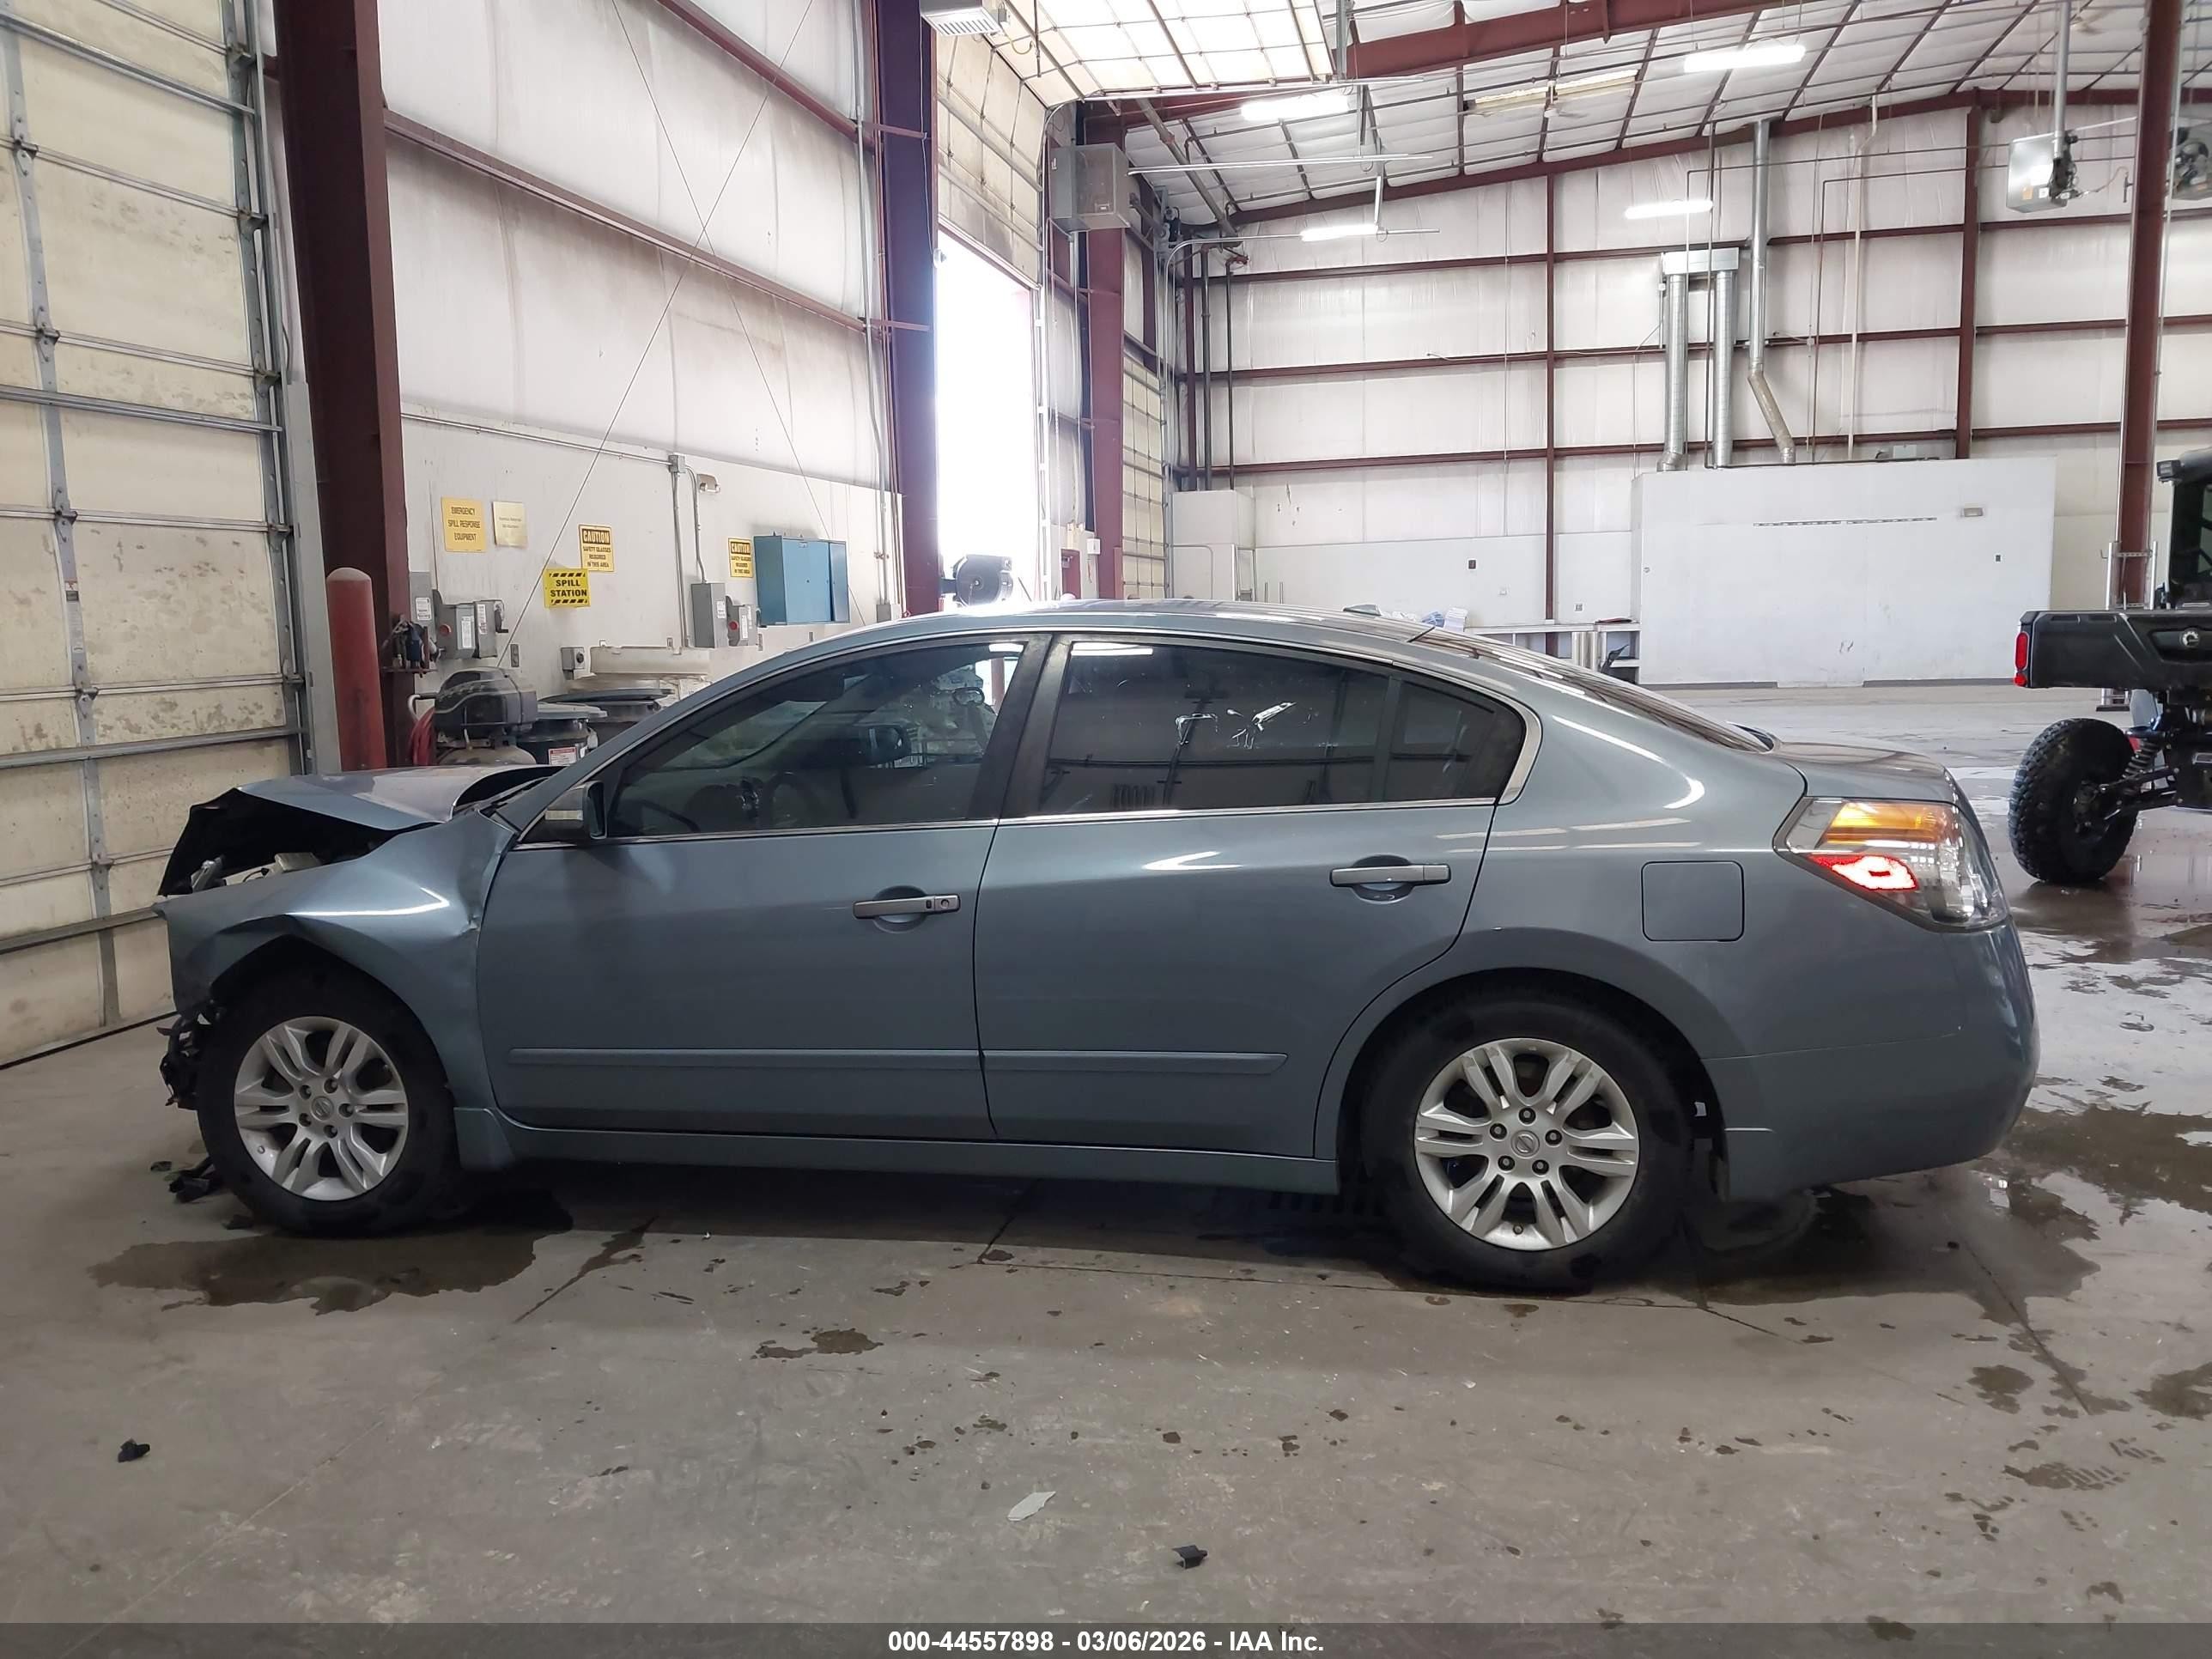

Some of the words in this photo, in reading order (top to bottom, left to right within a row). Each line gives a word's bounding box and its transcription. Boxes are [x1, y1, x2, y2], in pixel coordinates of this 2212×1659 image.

[451, 507, 475, 515] EMERGENCY
[453, 532, 477, 541] EQUIPMENT
[584, 531, 610, 544] CAUTION
